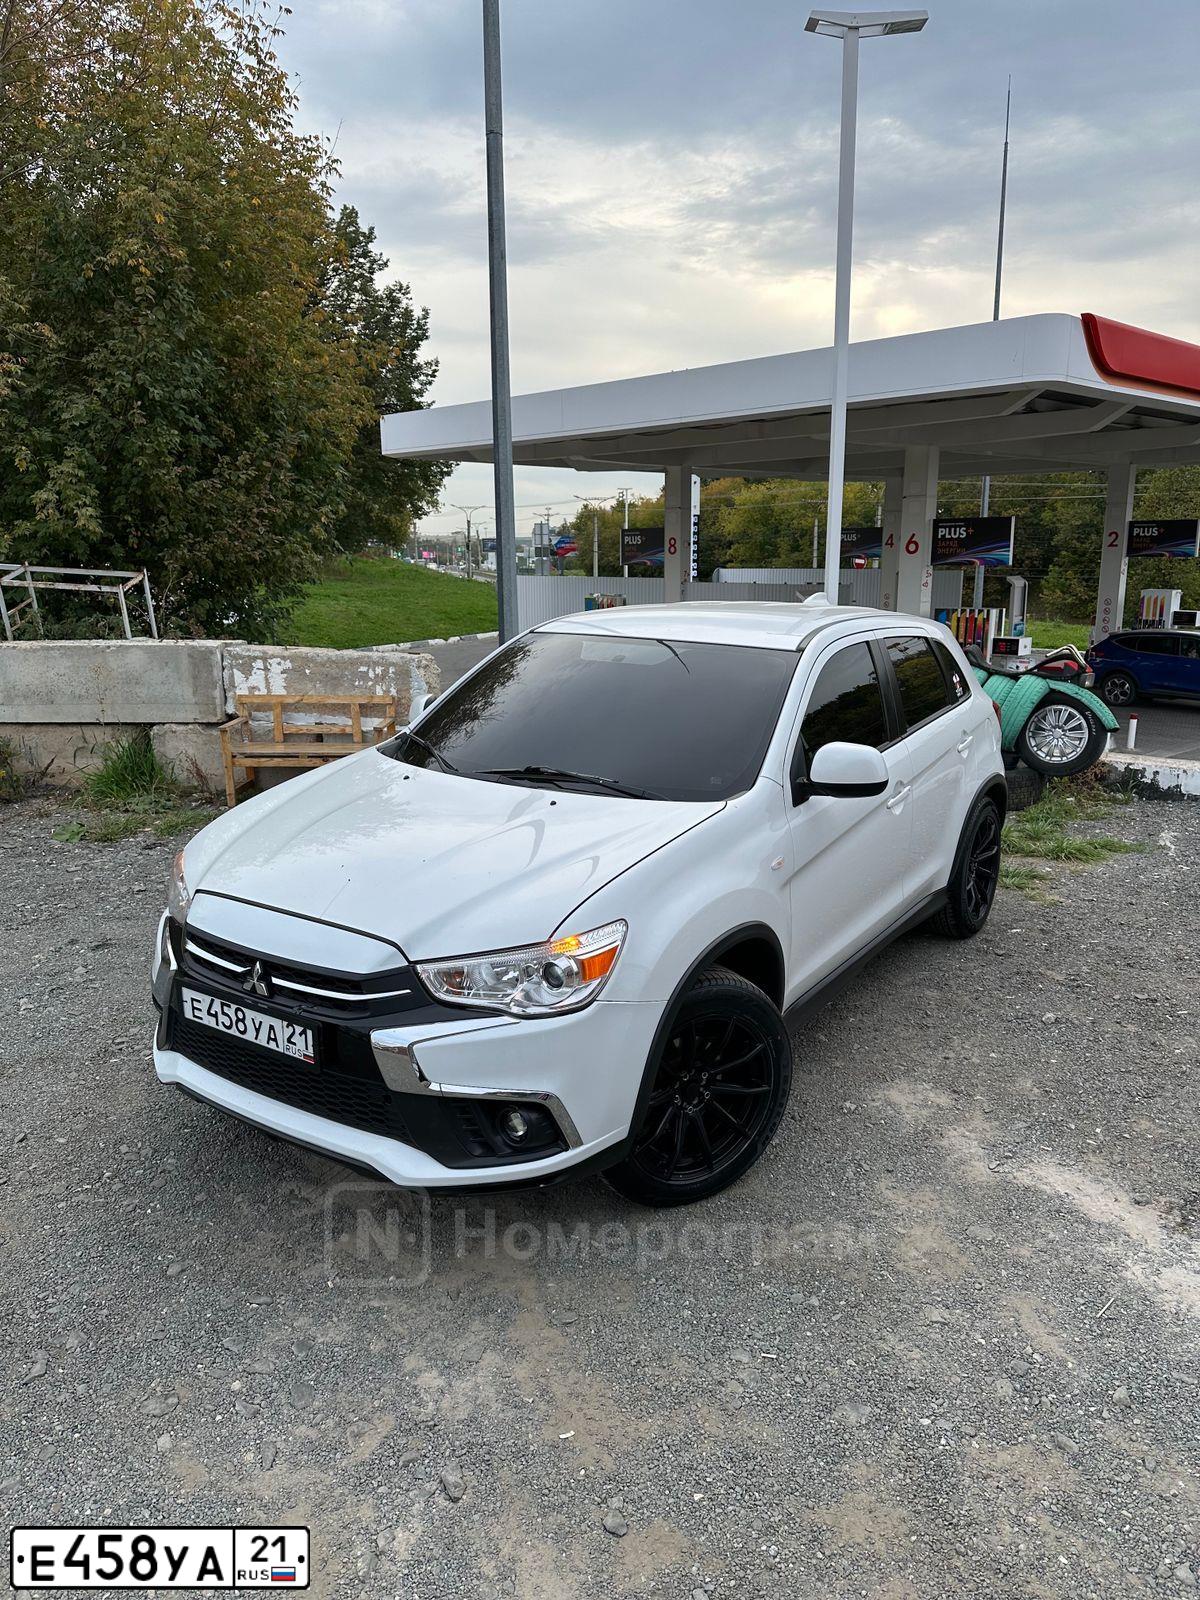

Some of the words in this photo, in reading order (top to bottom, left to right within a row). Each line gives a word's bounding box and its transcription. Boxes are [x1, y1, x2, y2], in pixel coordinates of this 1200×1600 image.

[668, 537, 677, 555] 8
[885, 533, 894, 549] 4
[905, 533, 920, 555] 6
[1107, 531, 1119, 548] 2
[190, 996, 280, 1049] Е458УА
[285, 1022, 310, 1051] 21
[285, 1044, 303, 1057] RUS
